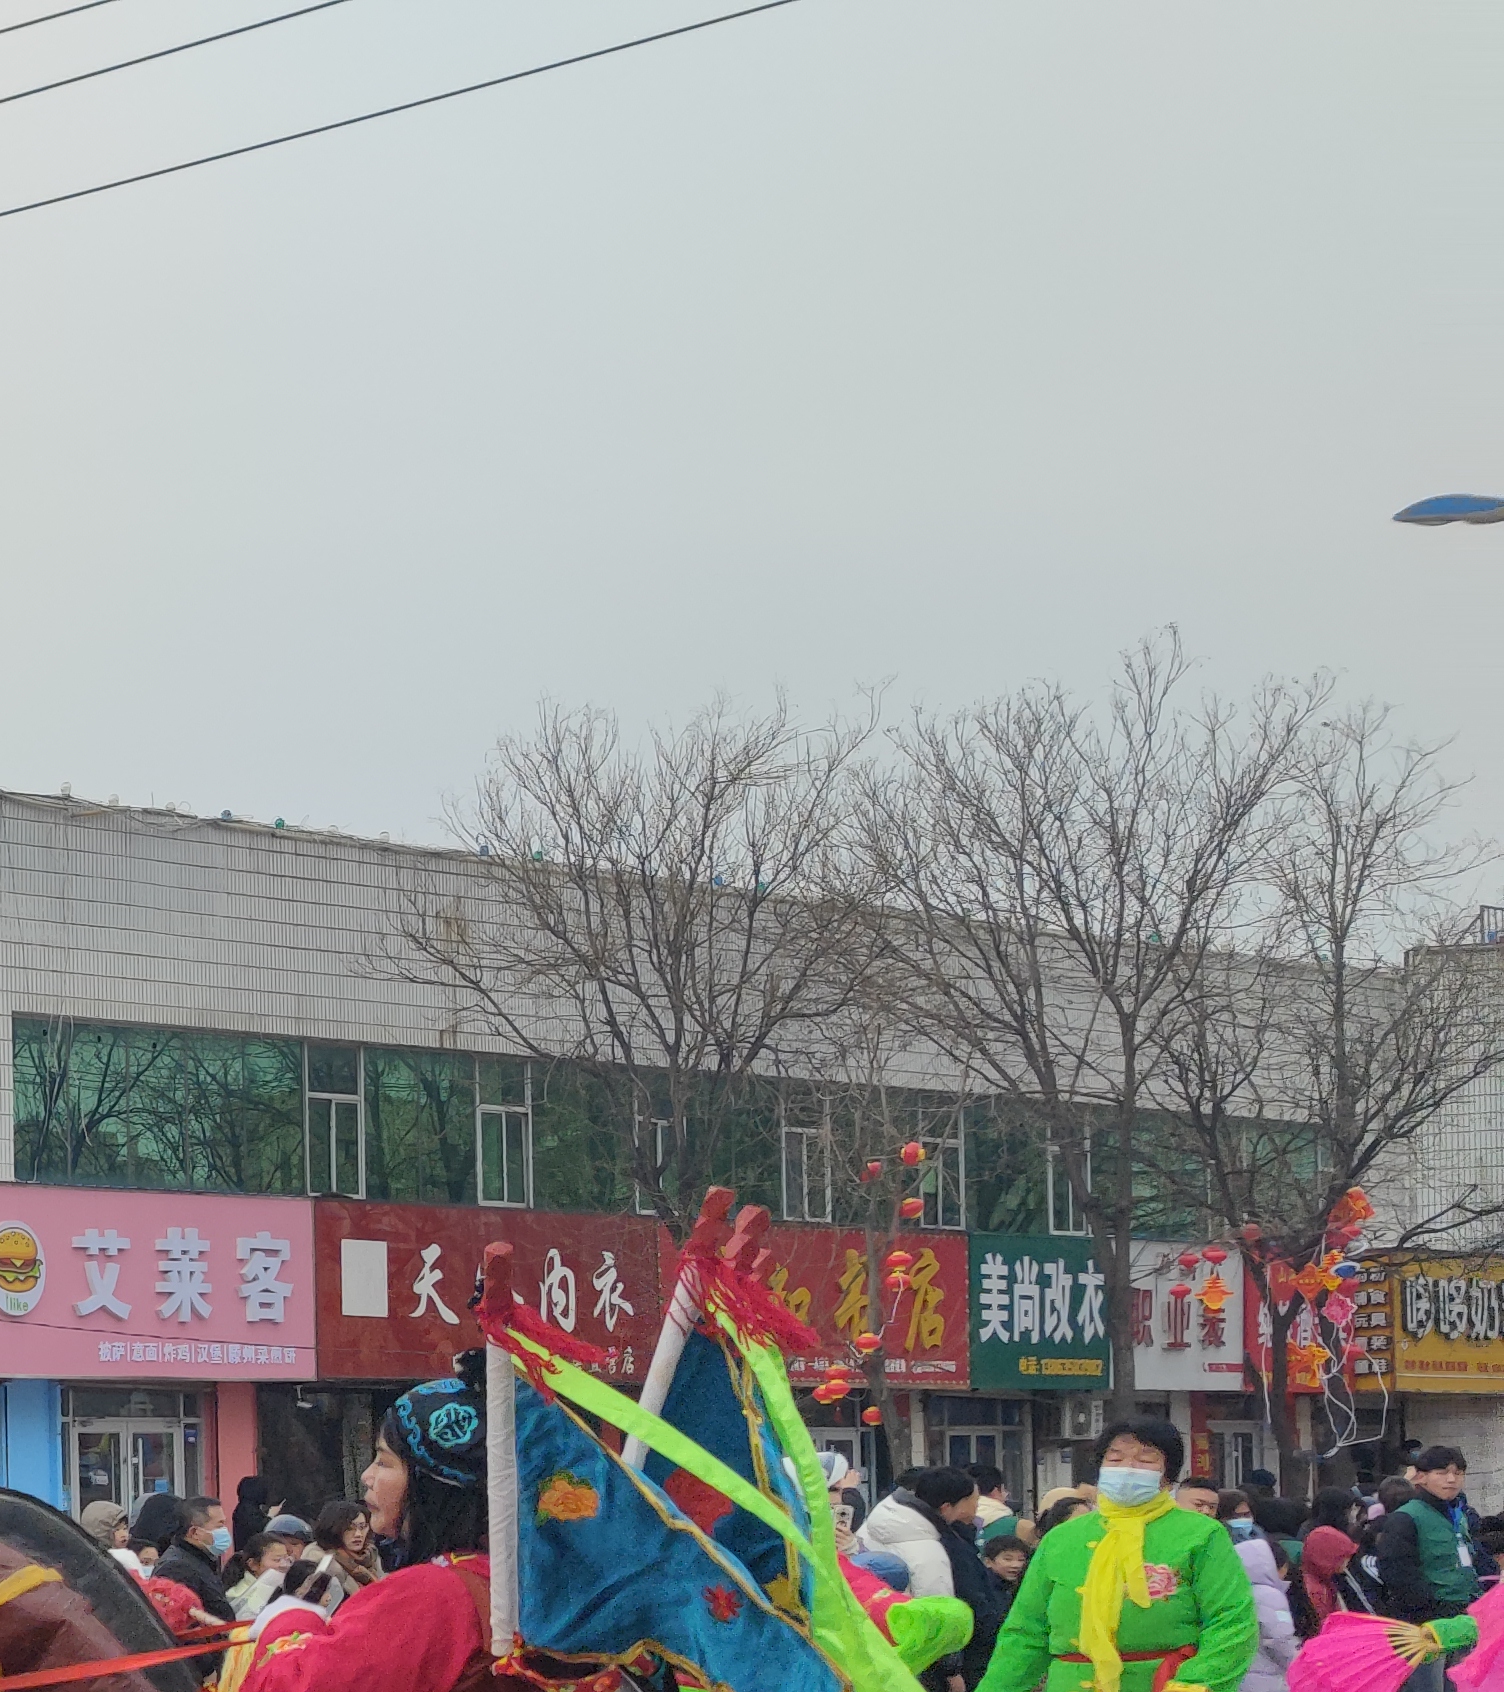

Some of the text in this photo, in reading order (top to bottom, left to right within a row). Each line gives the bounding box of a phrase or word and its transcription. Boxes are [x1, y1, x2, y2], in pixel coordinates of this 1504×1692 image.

[71, 1227, 294, 1323] 艾莱客
[408, 1243, 635, 1332] 天内衣
[979, 1252, 1106, 1344] 美尚改衣
[1354, 1312, 1387, 1328] 玩具
